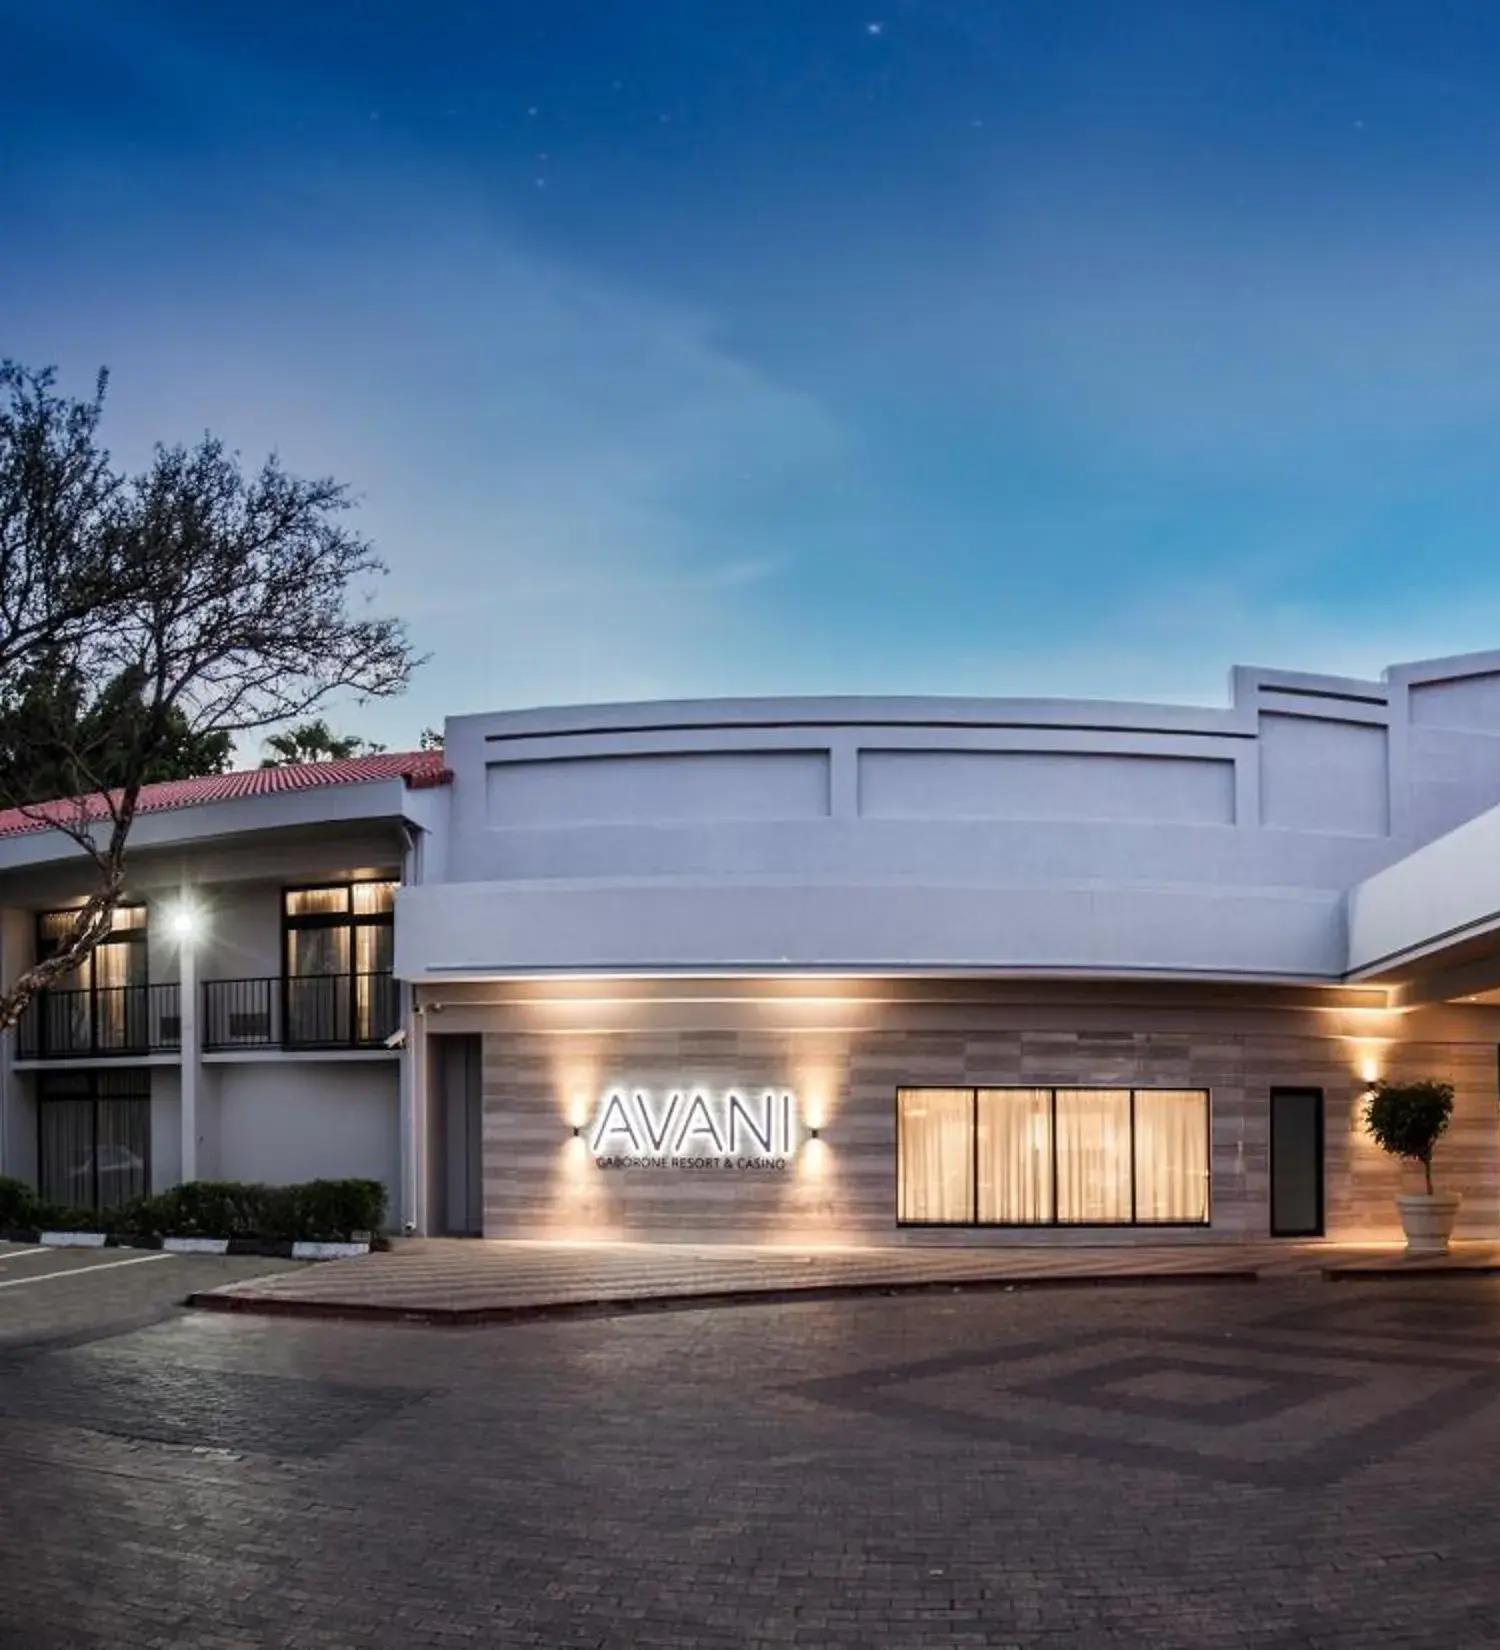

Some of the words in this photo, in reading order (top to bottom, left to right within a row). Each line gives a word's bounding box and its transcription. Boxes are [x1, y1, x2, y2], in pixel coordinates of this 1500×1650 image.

[593, 1094, 788, 1152] AVANI
[595, 1157, 667, 1170] GABORONE
[671, 1157, 719, 1170] RESORT
[723, 1157, 733, 1169] &
[737, 1157, 785, 1170] CASINO
